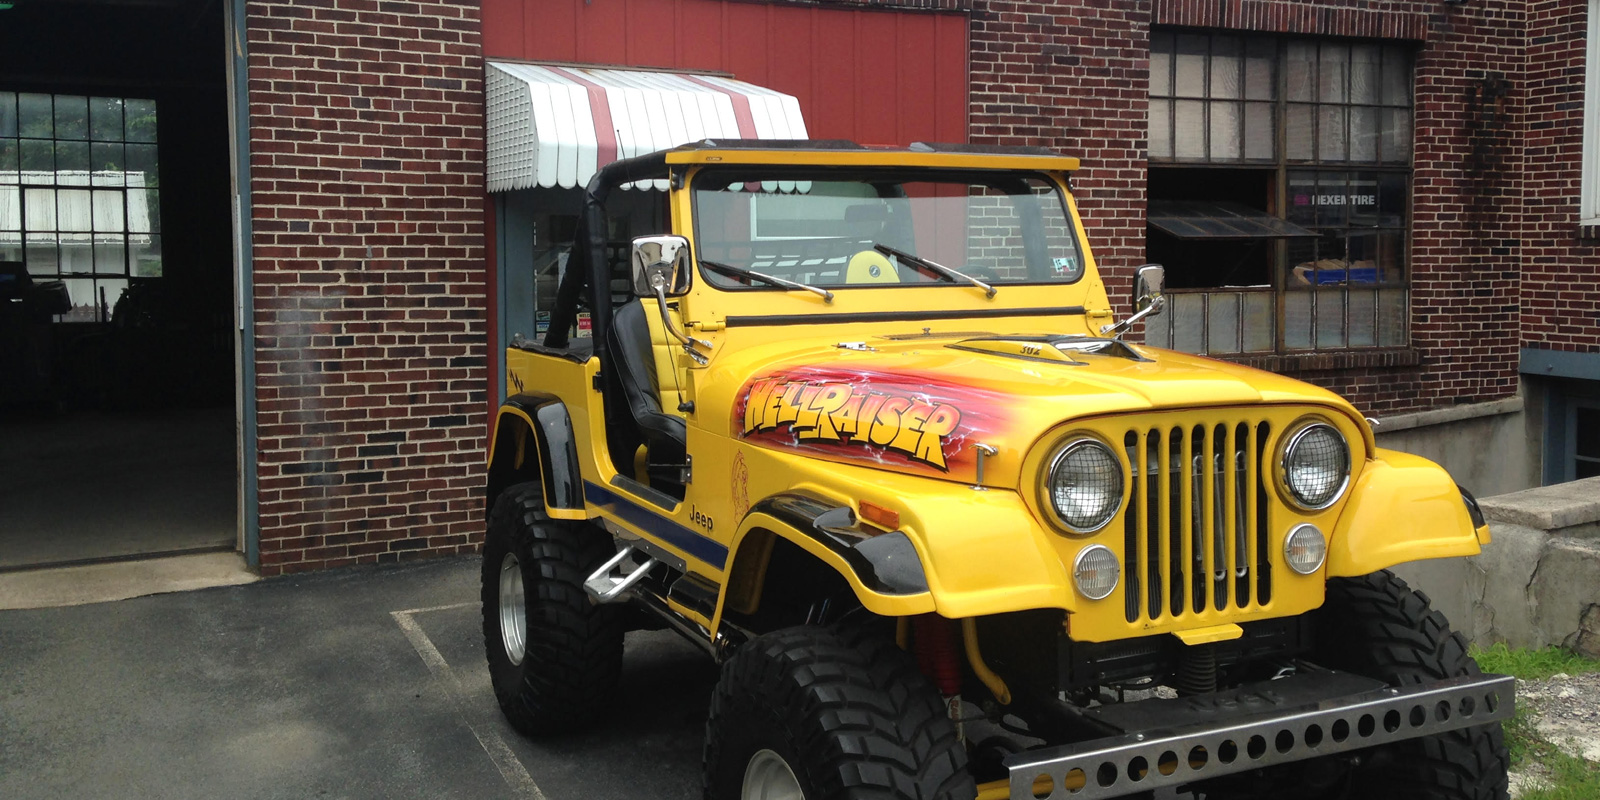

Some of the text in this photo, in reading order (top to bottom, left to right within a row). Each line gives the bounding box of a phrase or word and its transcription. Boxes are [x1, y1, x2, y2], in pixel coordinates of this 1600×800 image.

[1311, 194, 1375, 206] NEXEN TIRE
[1020, 345, 1041, 356] 302
[689, 504, 714, 534] Jeep
